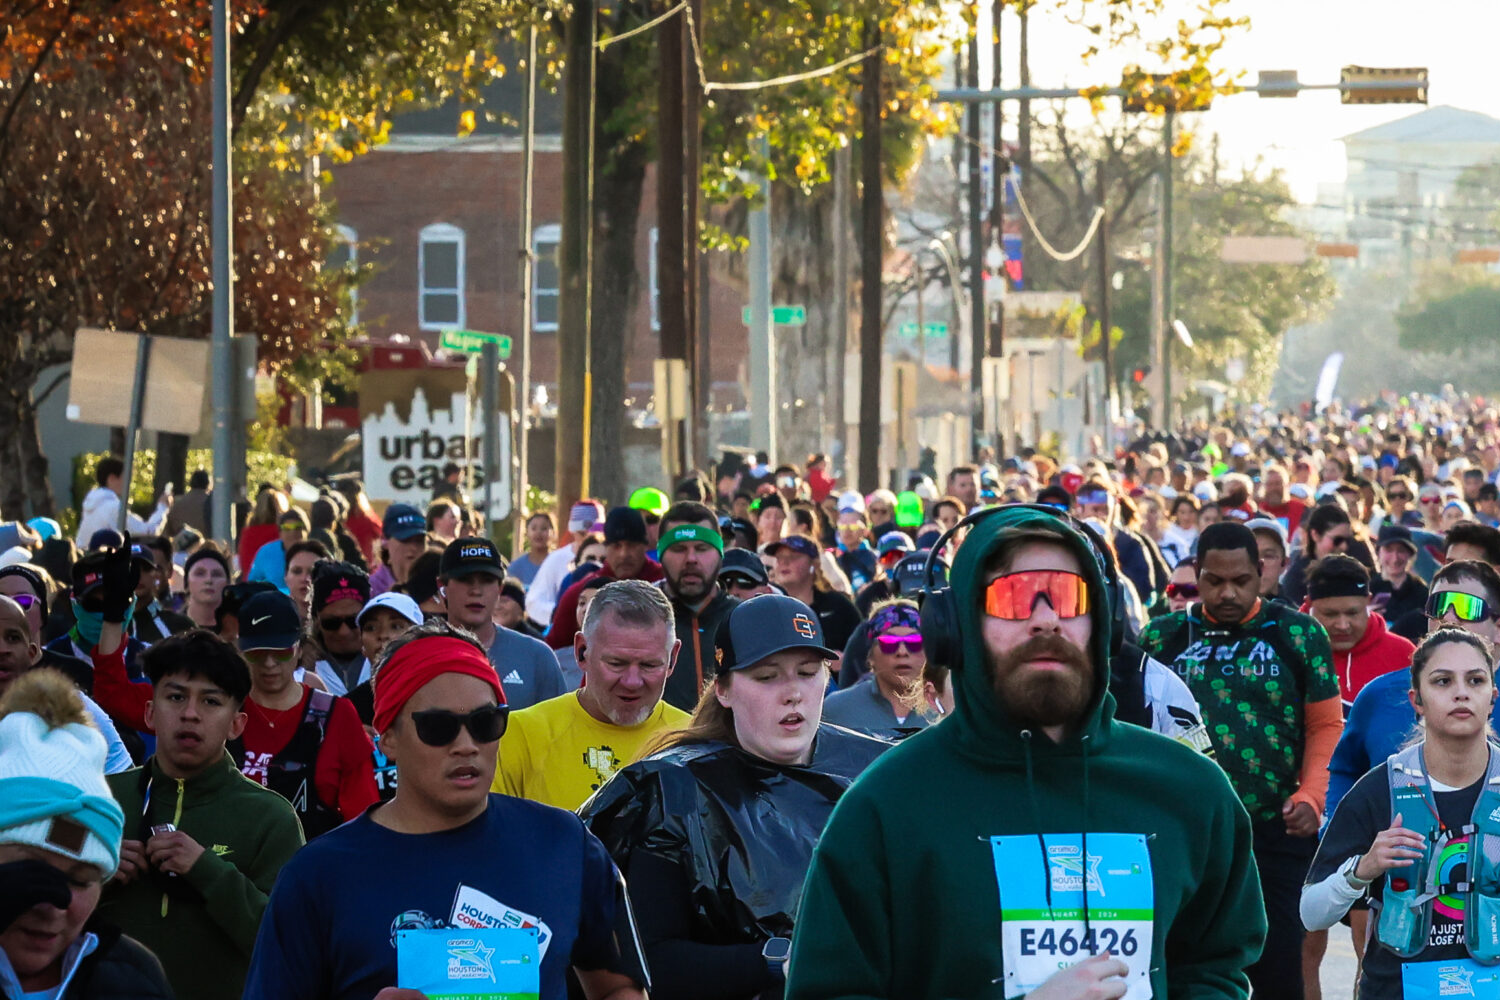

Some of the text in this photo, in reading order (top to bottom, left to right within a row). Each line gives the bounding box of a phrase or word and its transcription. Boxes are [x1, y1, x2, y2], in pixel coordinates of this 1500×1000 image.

[390, 464, 485, 490] eas
[460, 547, 493, 559] HOPE
[1170, 664, 1280, 676] UN CLUB
[460, 903, 513, 930] HOUSTO
[1020, 928, 1139, 957] E46426
[1427, 935, 1454, 946] LOSE
